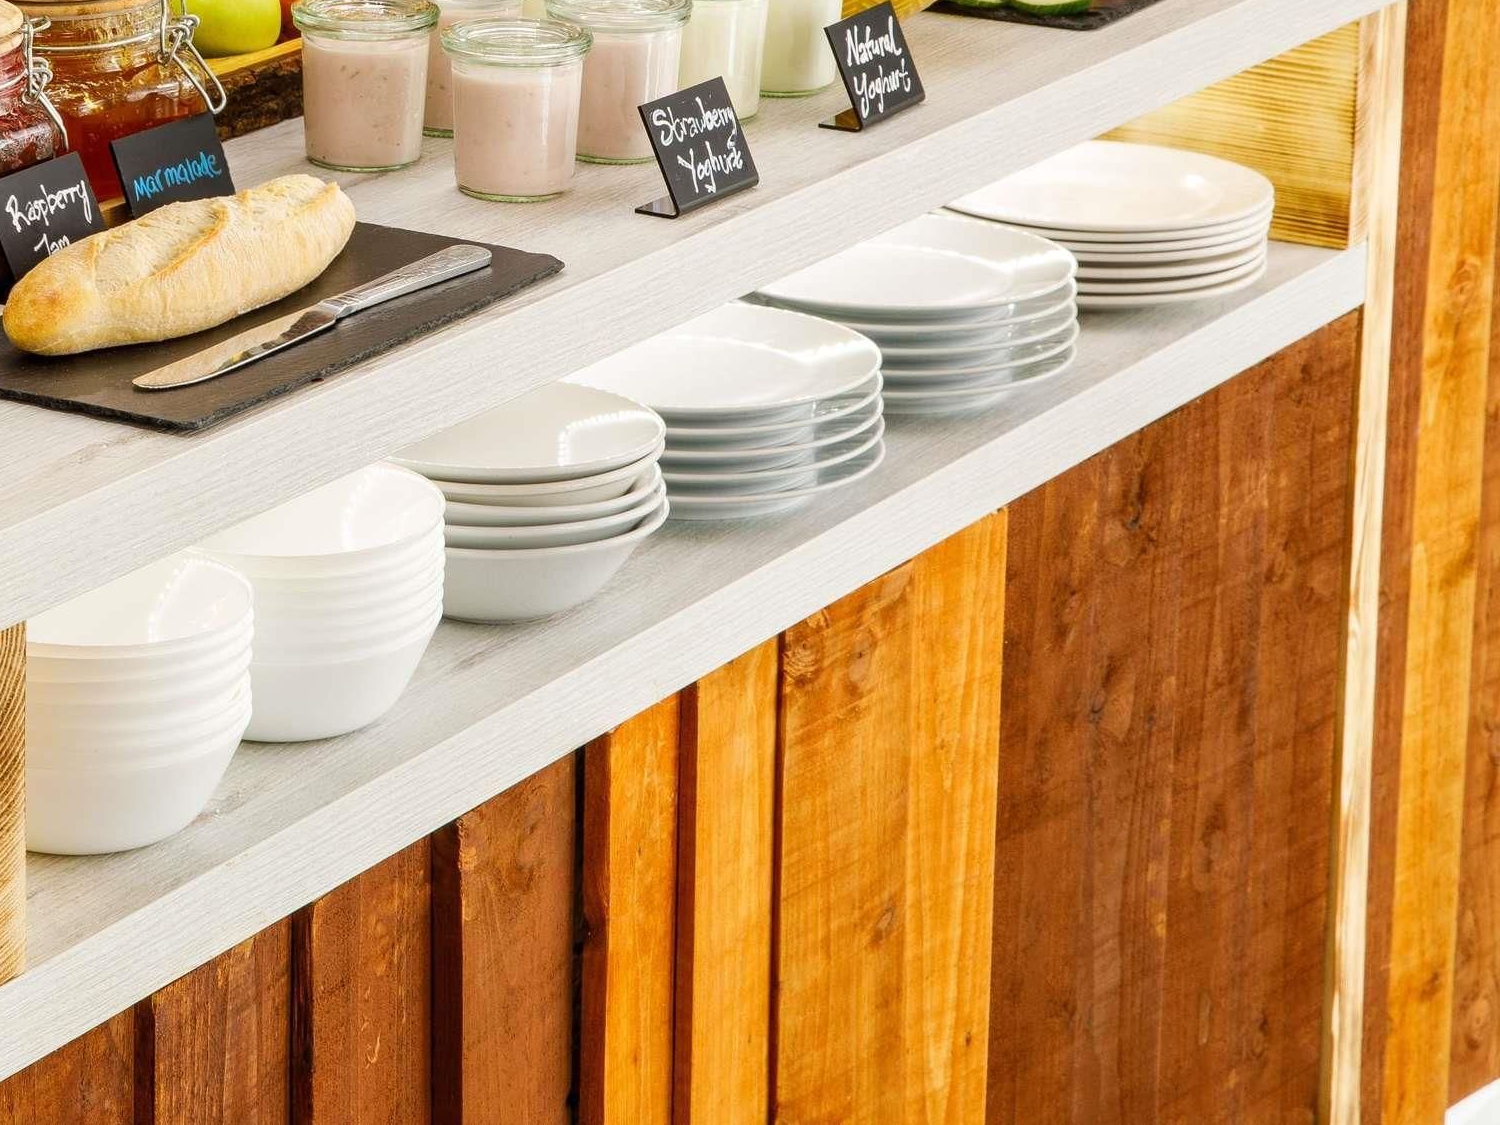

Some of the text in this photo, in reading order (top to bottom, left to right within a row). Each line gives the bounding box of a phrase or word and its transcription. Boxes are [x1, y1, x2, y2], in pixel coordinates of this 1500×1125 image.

[846, 16, 902, 67] Natural
[853, 58, 912, 118] Yoghurt
[652, 96, 737, 148] Strawberry
[133, 152, 223, 202] Marmalade
[677, 140, 743, 193] Yoghurt
[5, 179, 93, 233] Raspberry
